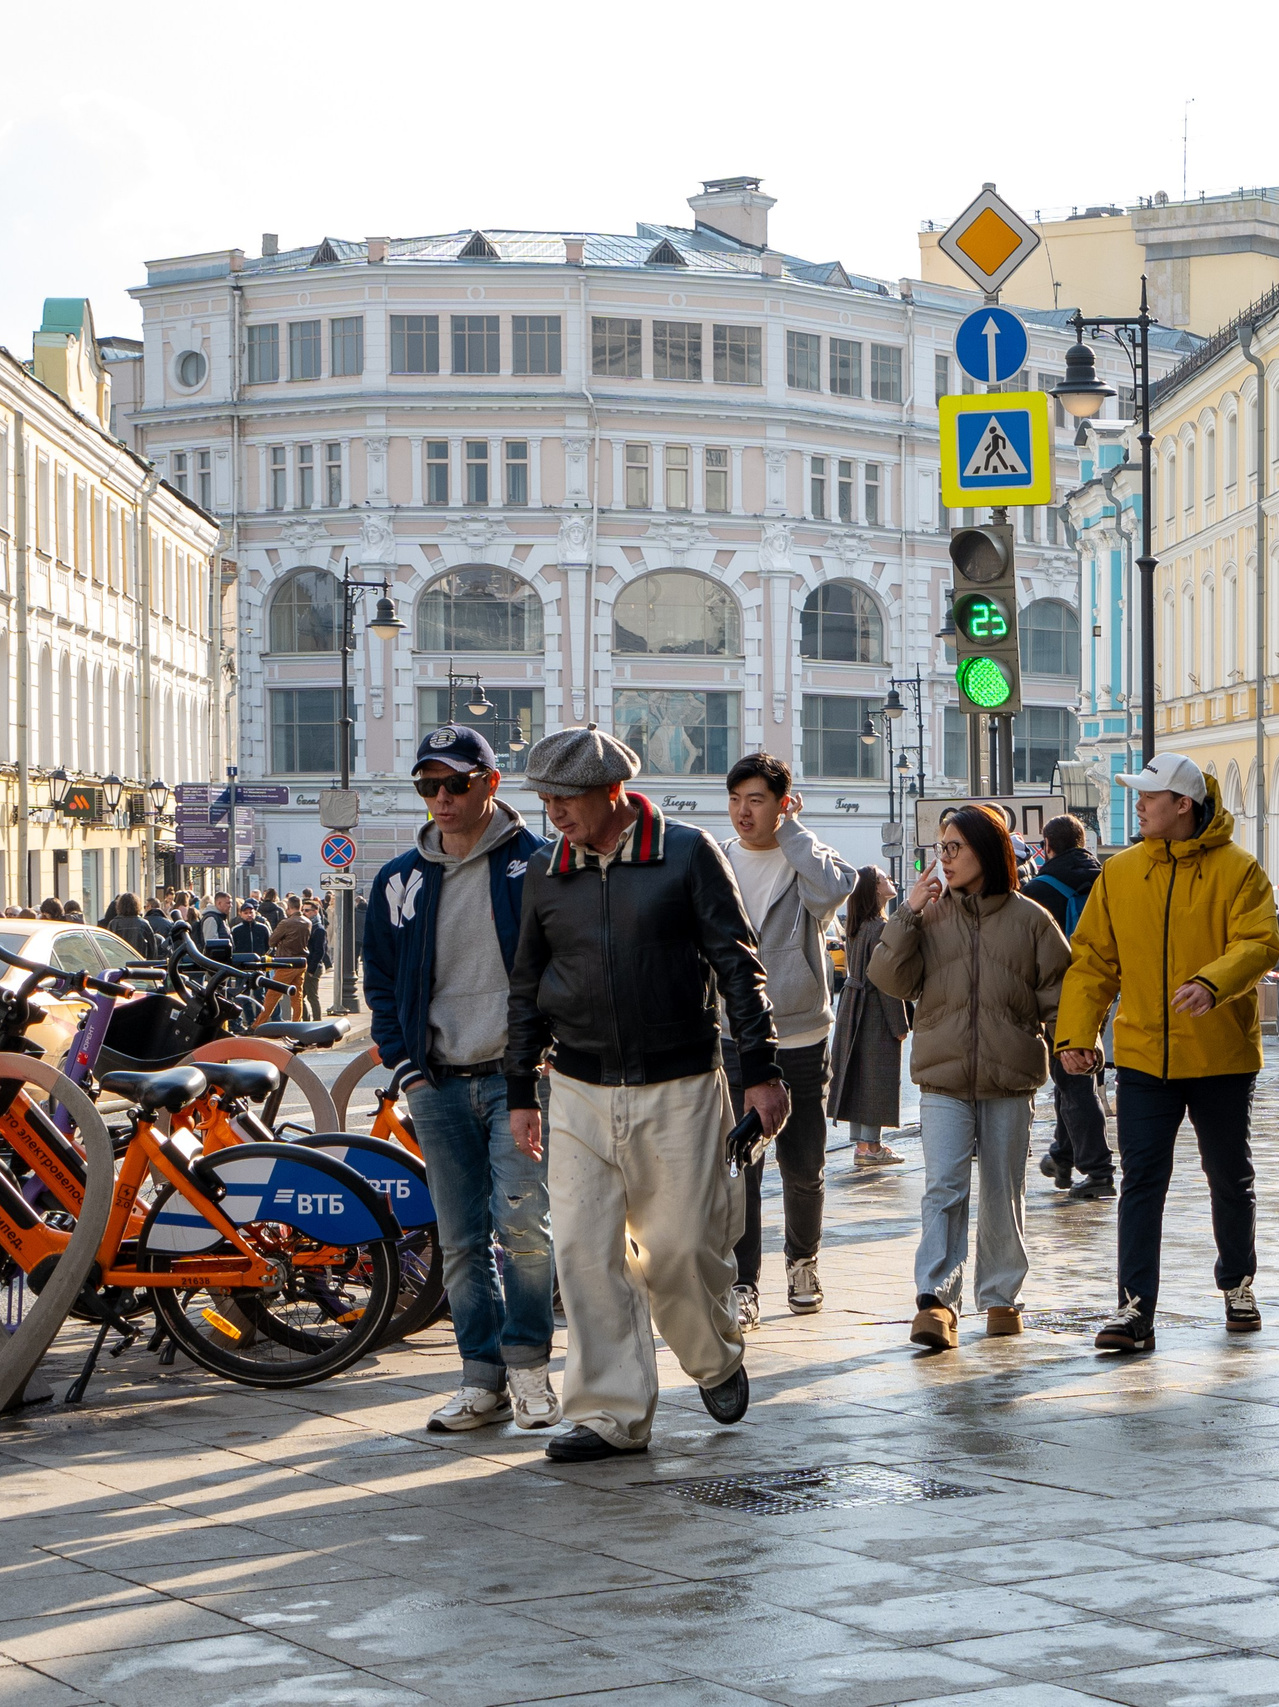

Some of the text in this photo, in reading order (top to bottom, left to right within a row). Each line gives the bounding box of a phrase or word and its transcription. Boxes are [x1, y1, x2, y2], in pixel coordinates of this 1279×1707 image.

[115, 1201, 131, 1209] 2.0
[297, 1194, 345, 1214] ВТБ
[181, 1277, 211, 1285] 21638
